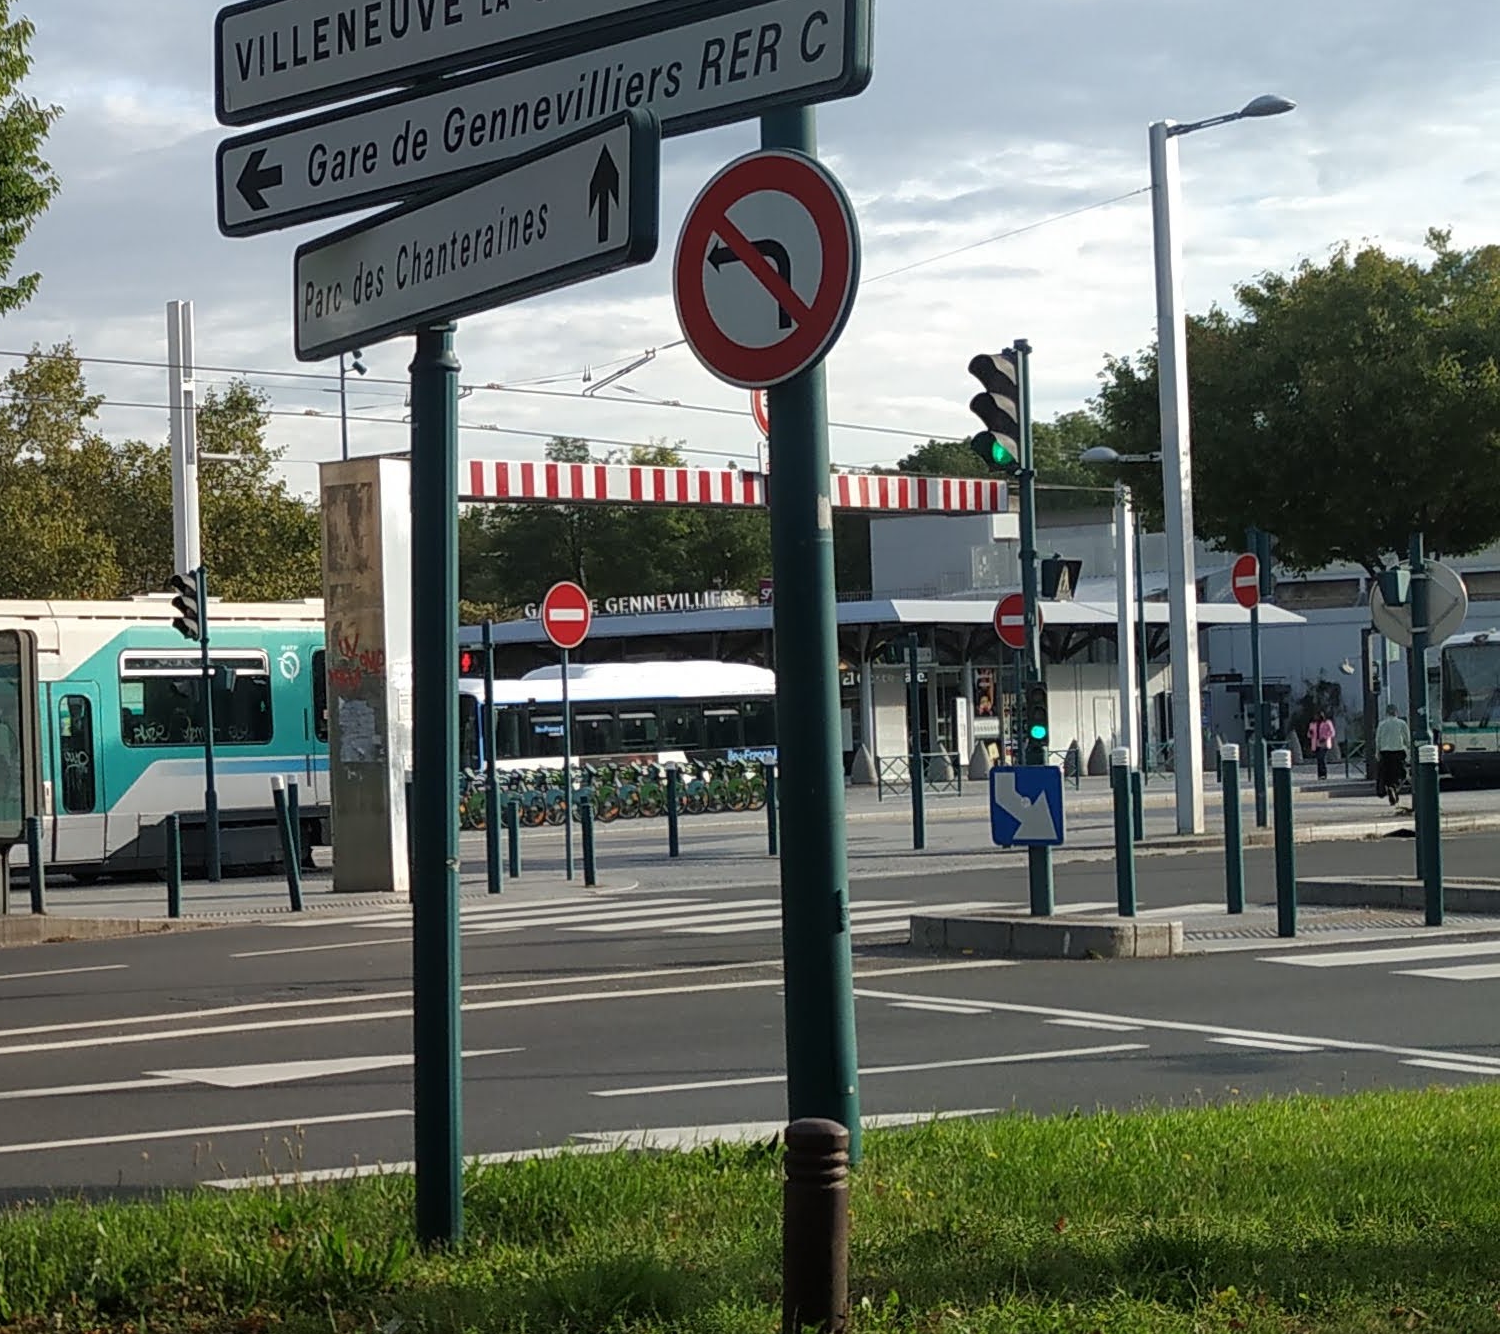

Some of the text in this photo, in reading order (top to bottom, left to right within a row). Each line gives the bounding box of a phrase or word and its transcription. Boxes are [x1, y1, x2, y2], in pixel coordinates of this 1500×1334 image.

[307, 9, 829, 187] Gare de Gennevilliers RER C
[303, 202, 549, 323] Parc des Chanteraines
[605, 589, 744, 614] GENNEVILLIERS
